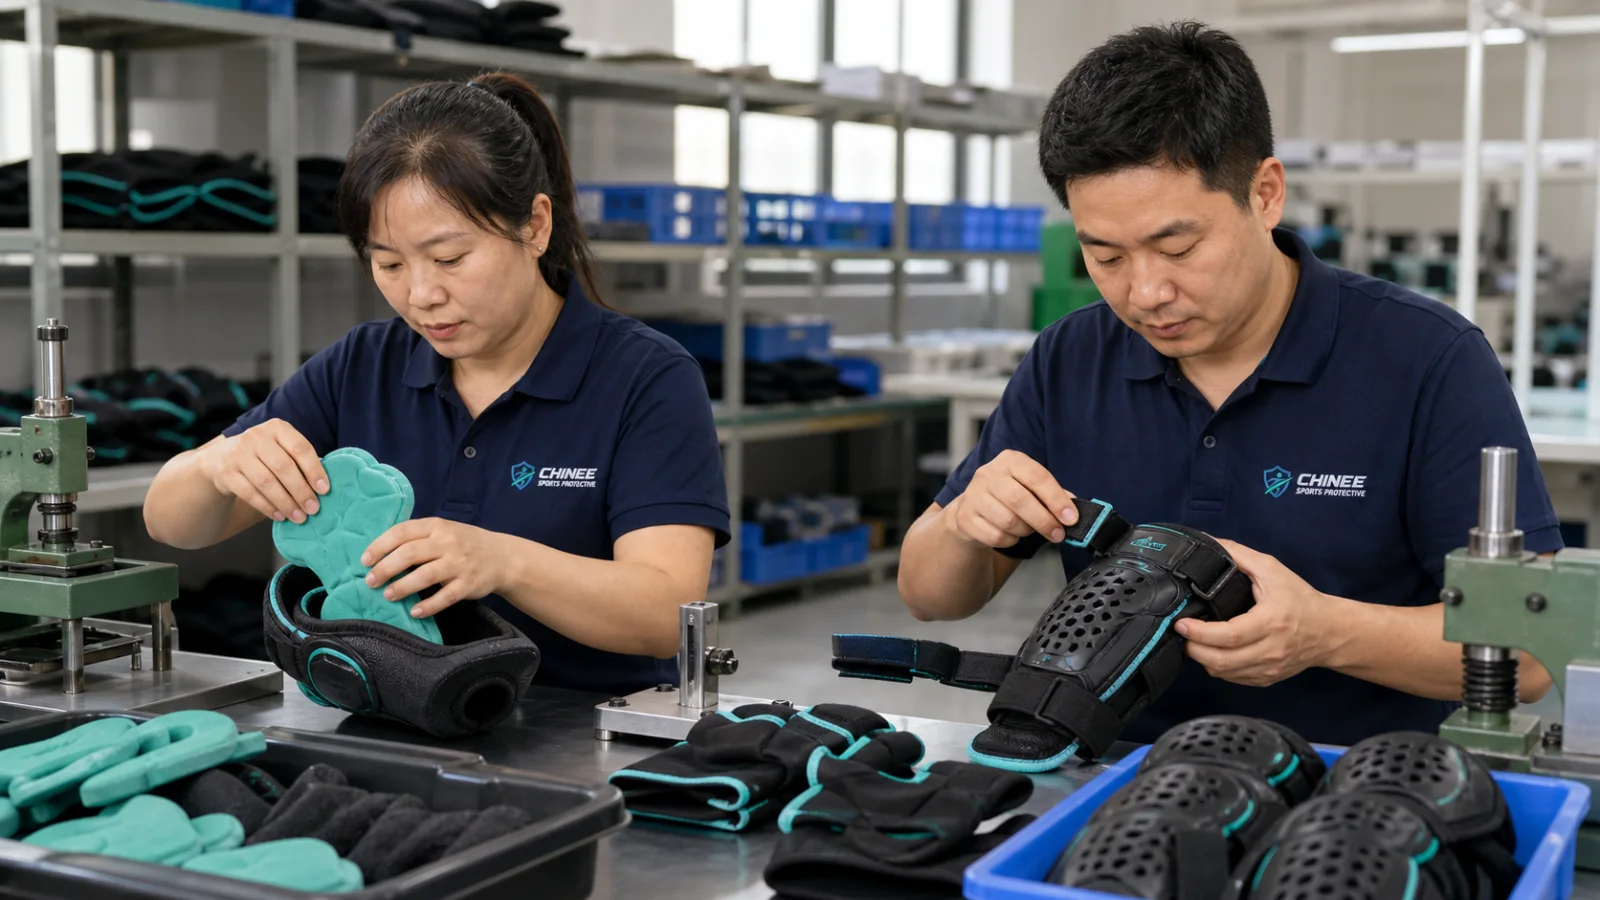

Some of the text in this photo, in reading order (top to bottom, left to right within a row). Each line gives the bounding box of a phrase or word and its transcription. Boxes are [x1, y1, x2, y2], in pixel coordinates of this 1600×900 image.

[538, 467, 598, 479] CHINEE
[1297, 473, 1367, 488] CHINEE
[1324, 489, 1366, 497] PROTECTIVE
